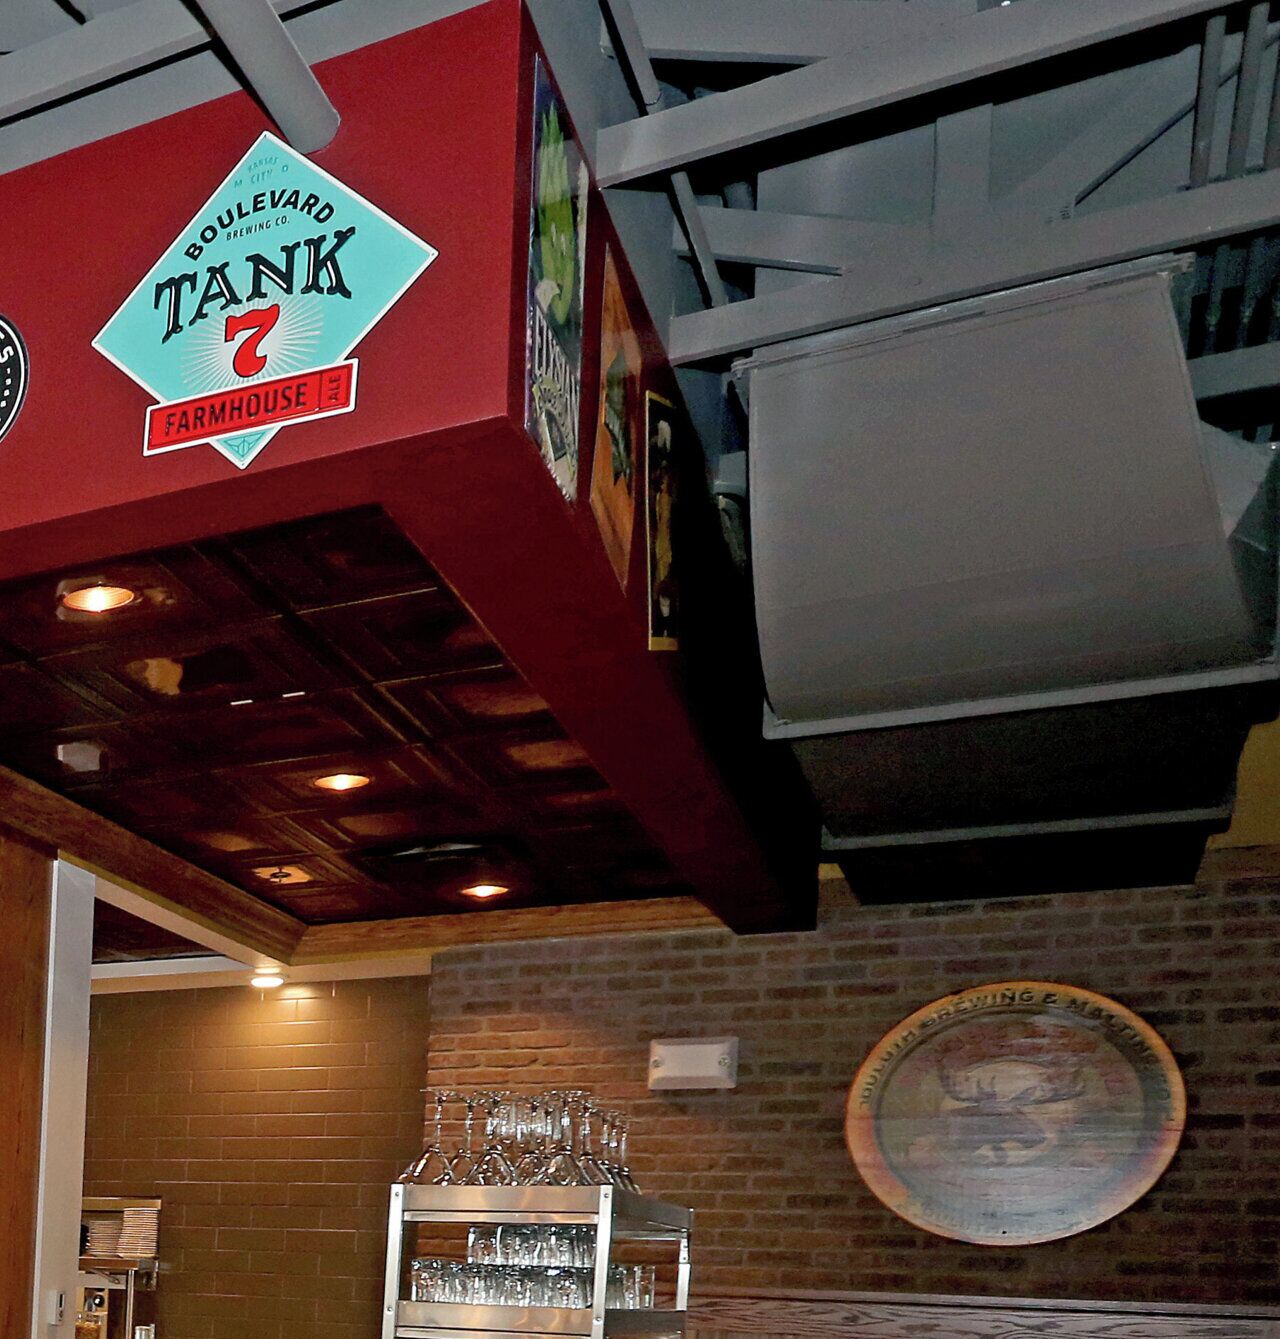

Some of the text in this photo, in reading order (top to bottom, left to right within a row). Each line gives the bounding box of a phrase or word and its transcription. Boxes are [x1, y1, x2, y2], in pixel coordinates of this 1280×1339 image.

[184, 189, 335, 261] BOULEVARD
[226, 215, 290, 241] BREWING CO.
[153, 227, 356, 345] TANK
[224, 303, 280, 378] 7
[165, 383, 308, 437] FARMHOUSE
[328, 375, 343, 403] ALE
[862, 1029, 917, 1099] DULUTH
[919, 991, 1034, 1029] BREWING
